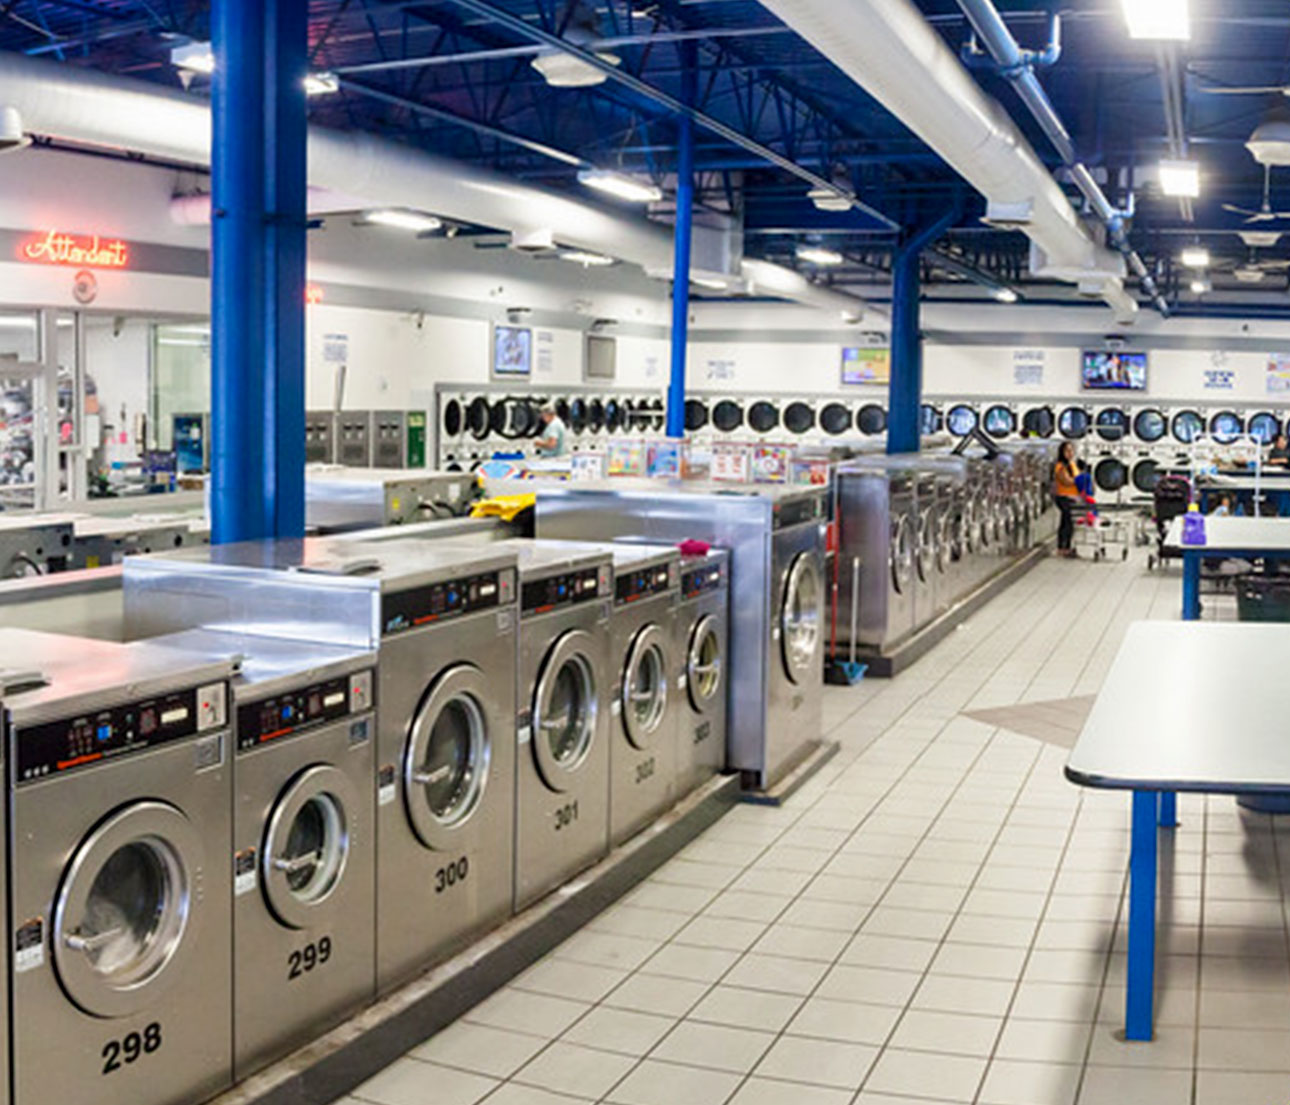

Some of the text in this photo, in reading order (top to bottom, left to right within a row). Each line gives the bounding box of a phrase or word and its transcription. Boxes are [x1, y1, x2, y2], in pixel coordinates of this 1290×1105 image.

[25, 228, 127, 266] Attendant
[635, 756, 656, 785] 302
[554, 799, 579, 832] 301
[435, 856, 469, 894] 300
[287, 936, 332, 981] 299
[101, 1022, 162, 1075] 298
